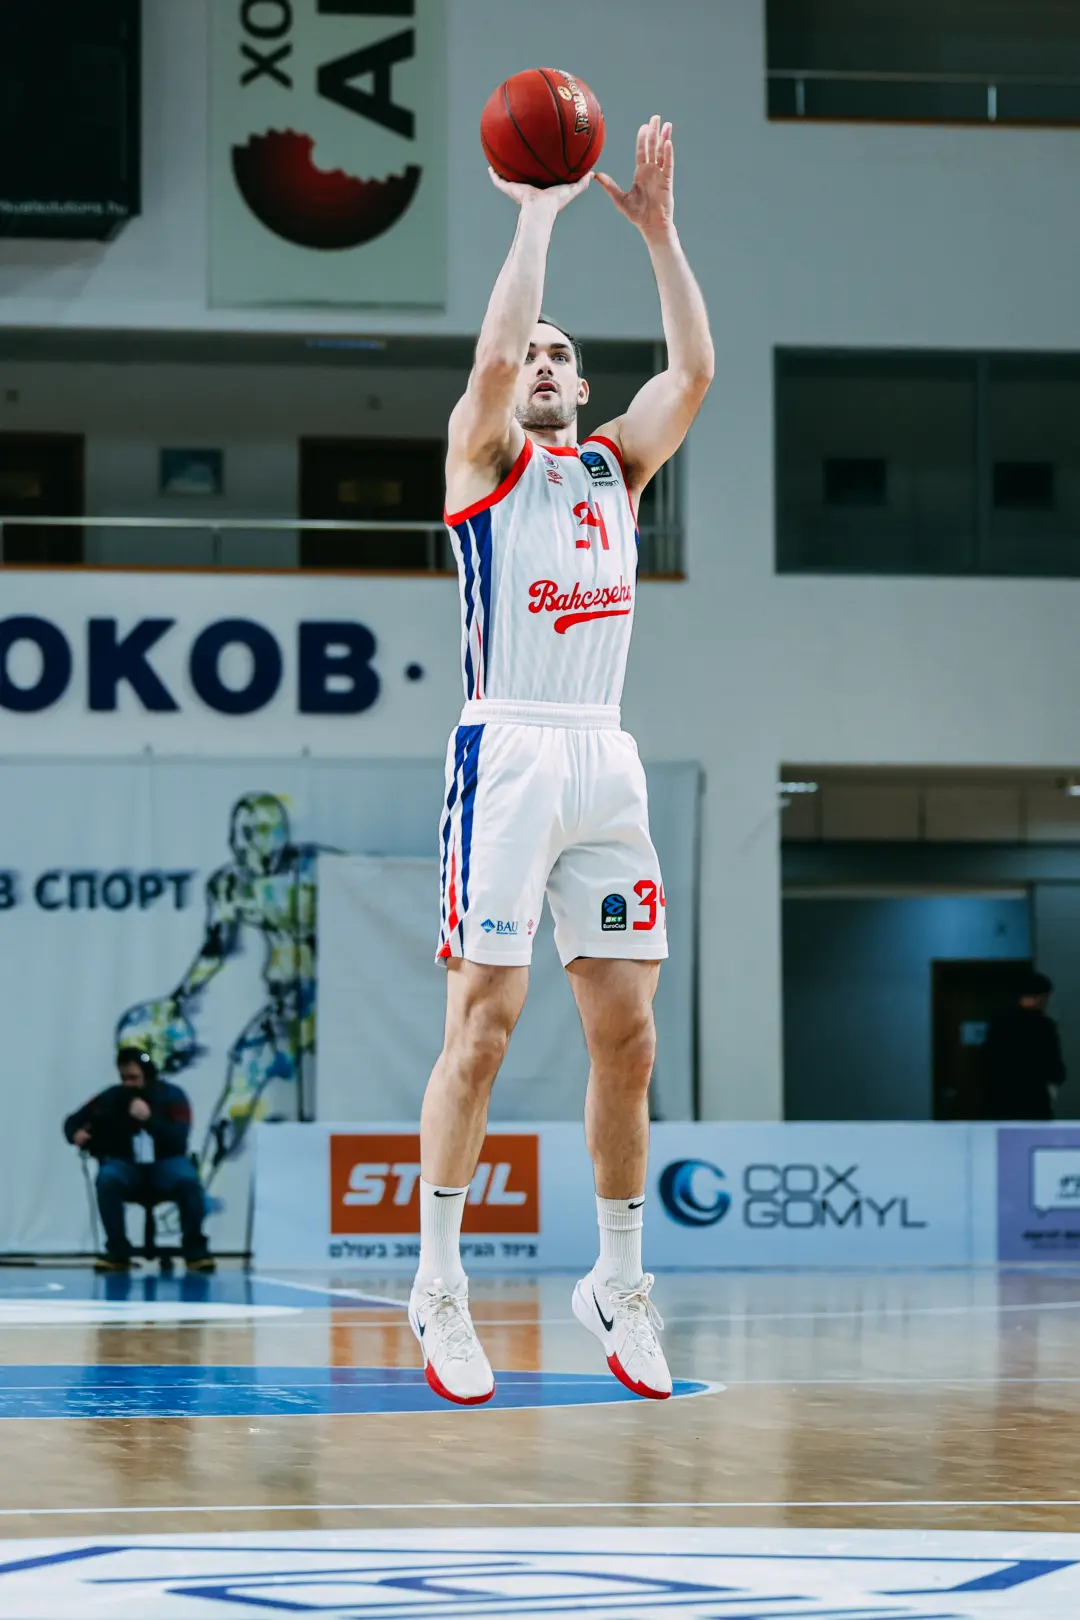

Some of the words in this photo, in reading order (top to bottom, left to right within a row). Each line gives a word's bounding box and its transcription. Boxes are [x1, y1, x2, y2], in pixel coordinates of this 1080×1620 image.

[316, 0, 415, 142] А
[35, 869, 196, 912] СПОРТ
[496, 920, 519, 932] BAU
[743, 1164, 861, 1196] COX
[743, 1196, 929, 1229] GOMYL
